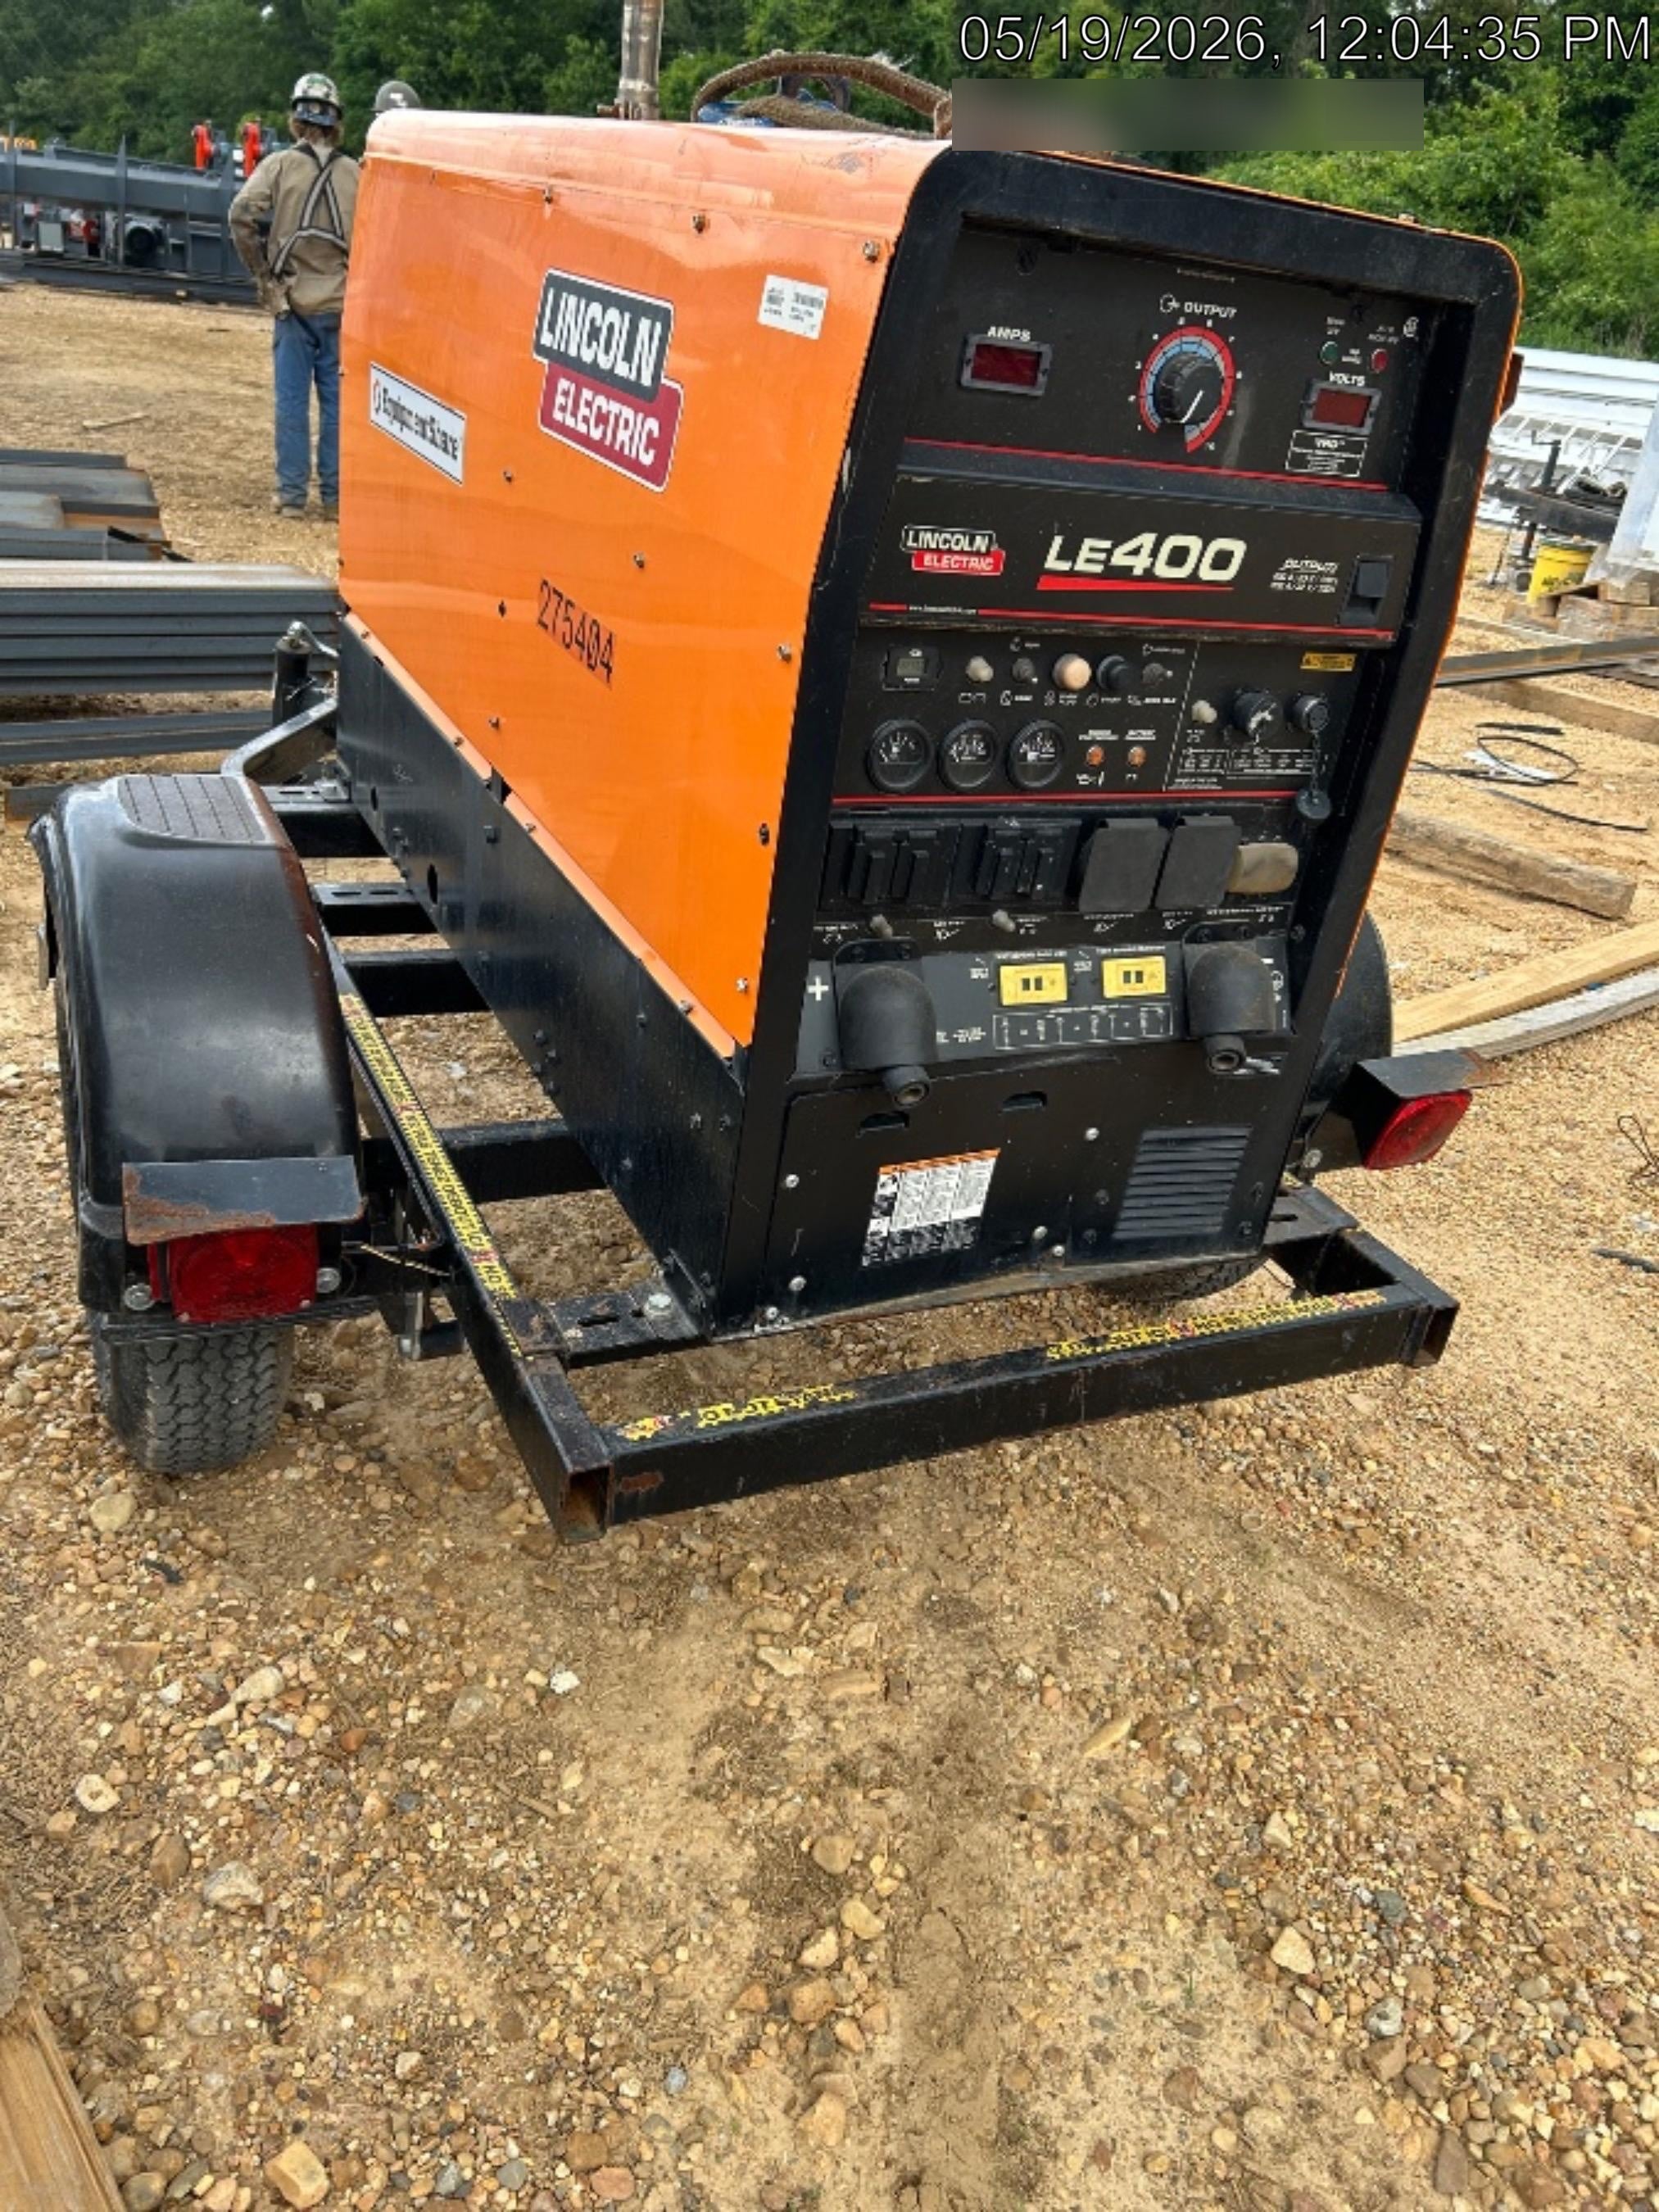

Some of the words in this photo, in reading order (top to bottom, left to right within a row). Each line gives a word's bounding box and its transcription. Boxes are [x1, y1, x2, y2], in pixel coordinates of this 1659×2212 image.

[1184, 301, 1238, 319] OUTPUT
[539, 285, 664, 388] LINCOLN
[986, 326, 1031, 342] AMPS
[1329, 370, 1366, 387] VOLTS
[552, 378, 661, 468] ELECTRIC
[906, 529, 990, 553] LINCOLN
[923, 552, 994, 571] ELECTRIC
[1043, 532, 1249, 582] LE400
[537, 578, 613, 684] 275404
